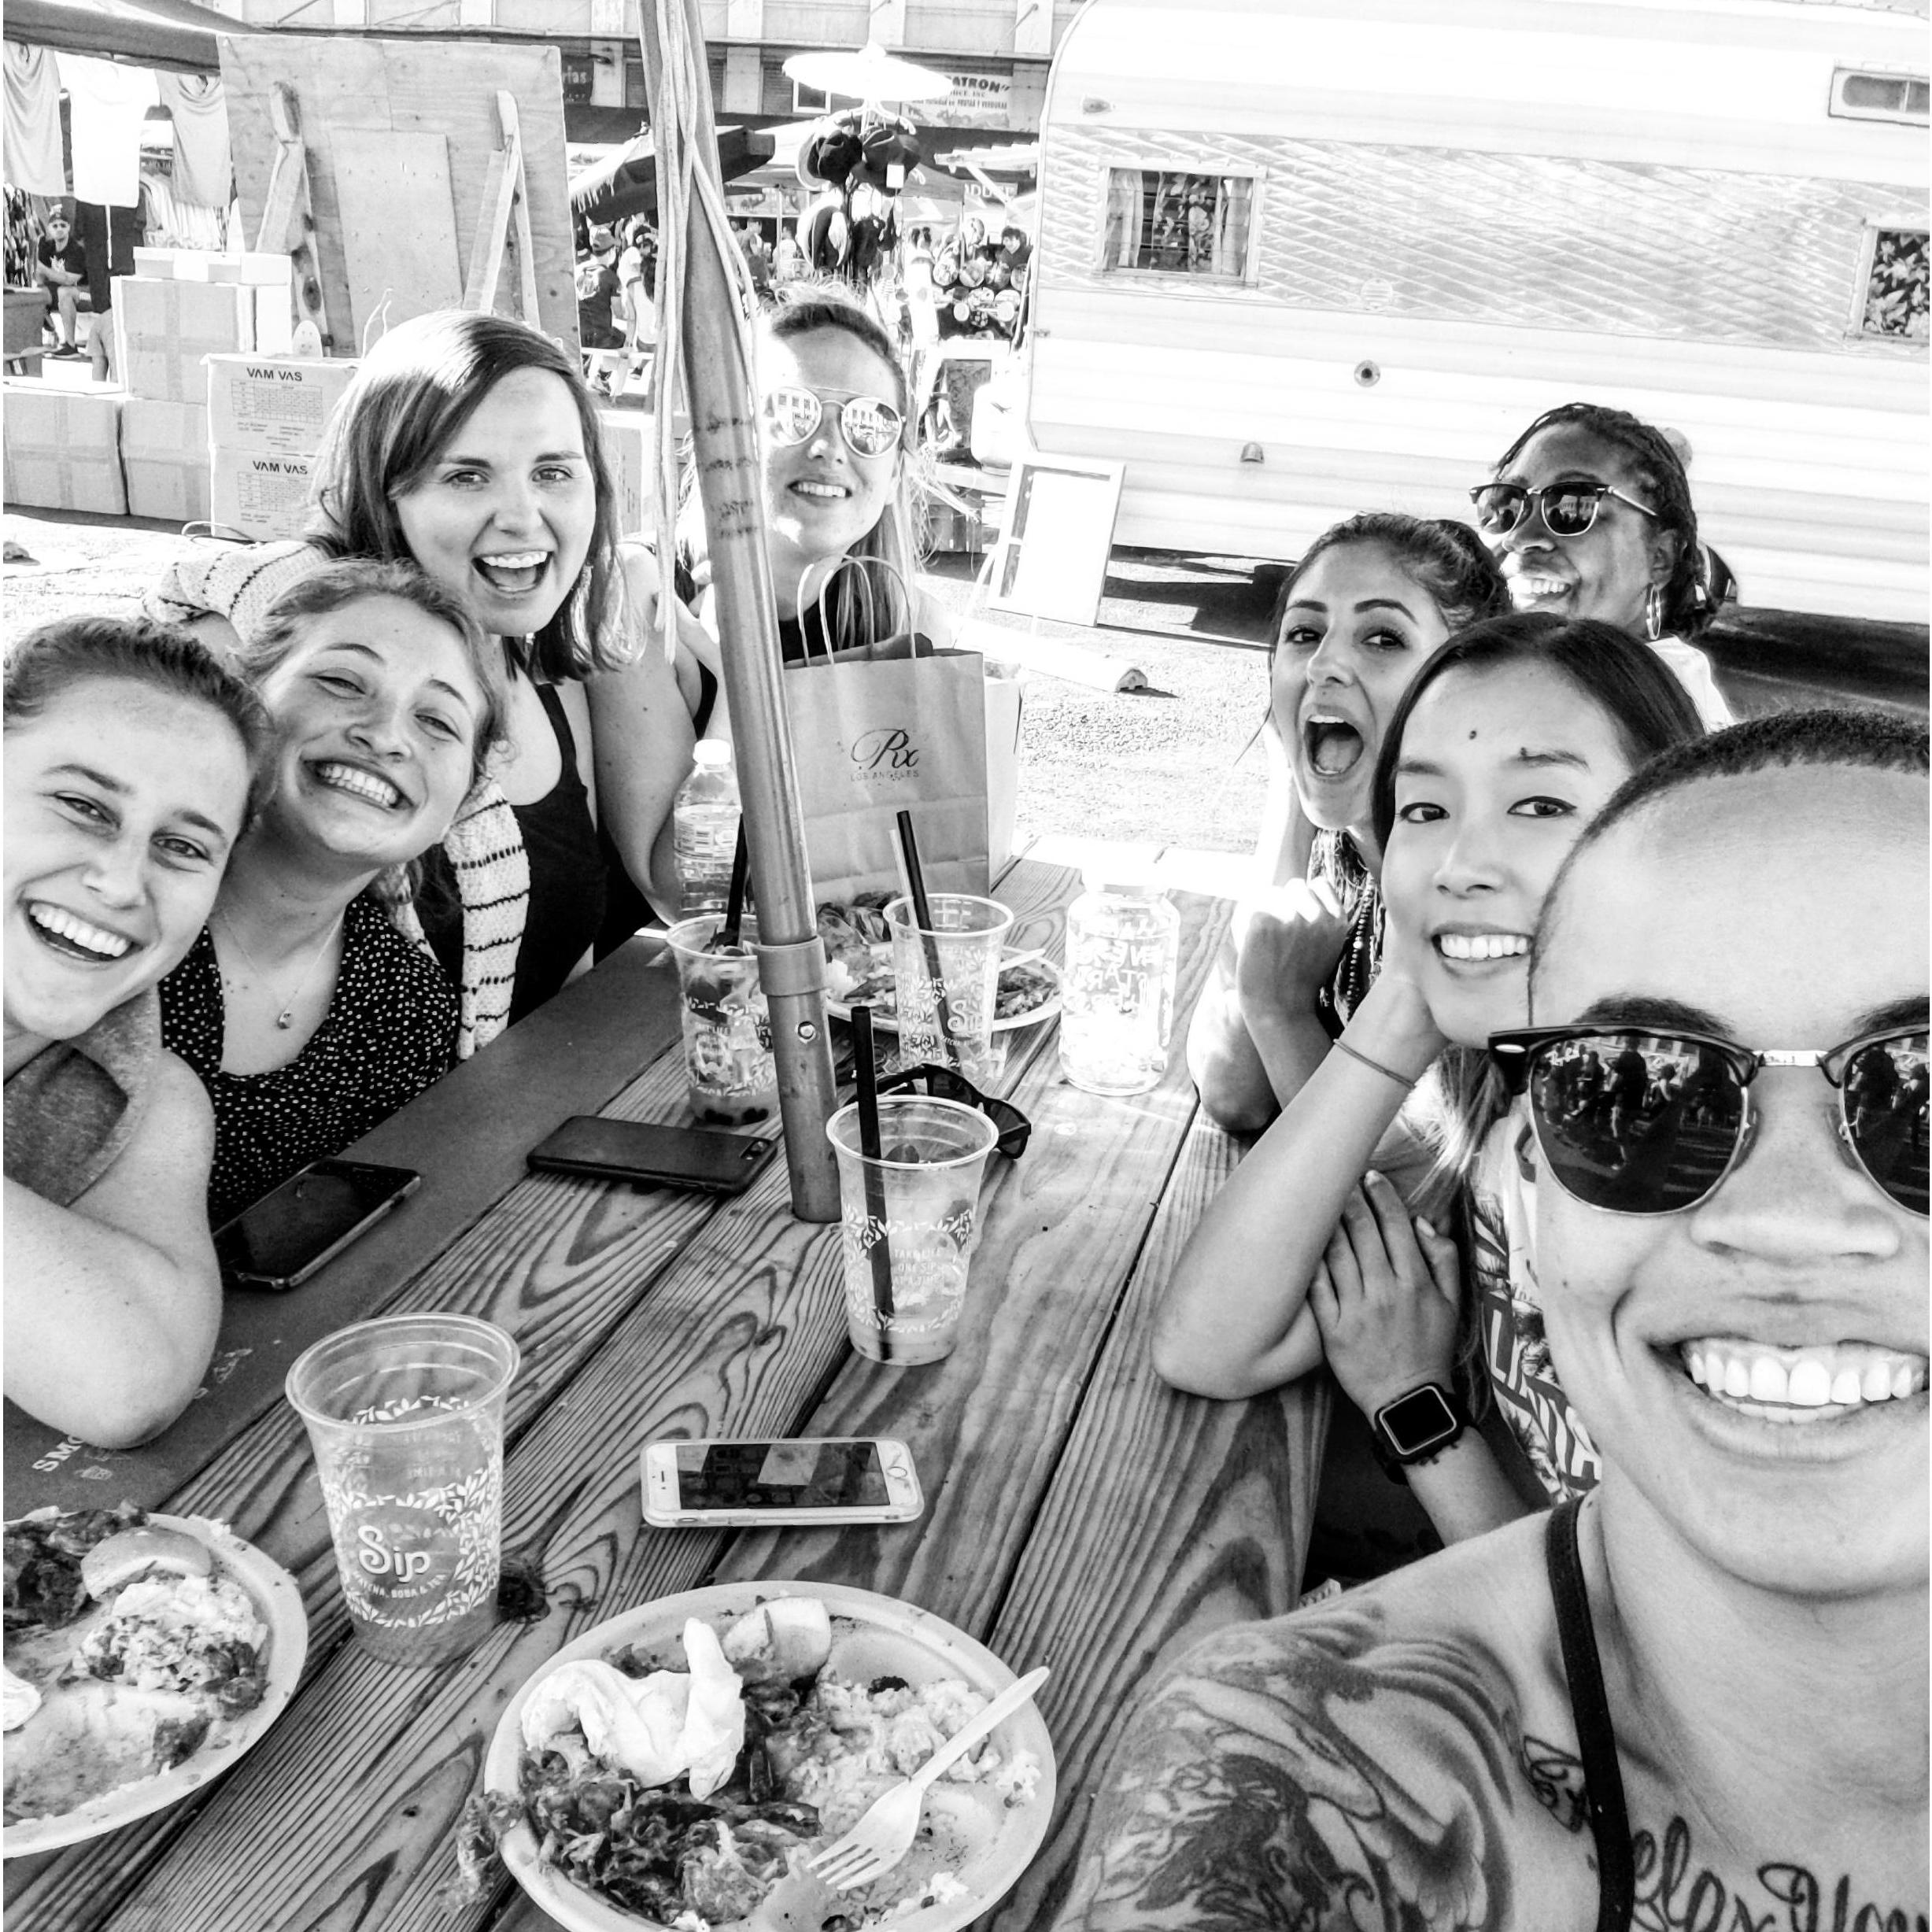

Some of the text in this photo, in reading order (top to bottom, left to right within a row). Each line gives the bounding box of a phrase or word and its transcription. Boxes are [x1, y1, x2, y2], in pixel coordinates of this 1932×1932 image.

[247, 367, 303, 382] VAM VAS
[253, 460, 308, 475] VAM VAS
[850, 728, 919, 770] Rx
[358, 1524, 431, 1583] Sip
